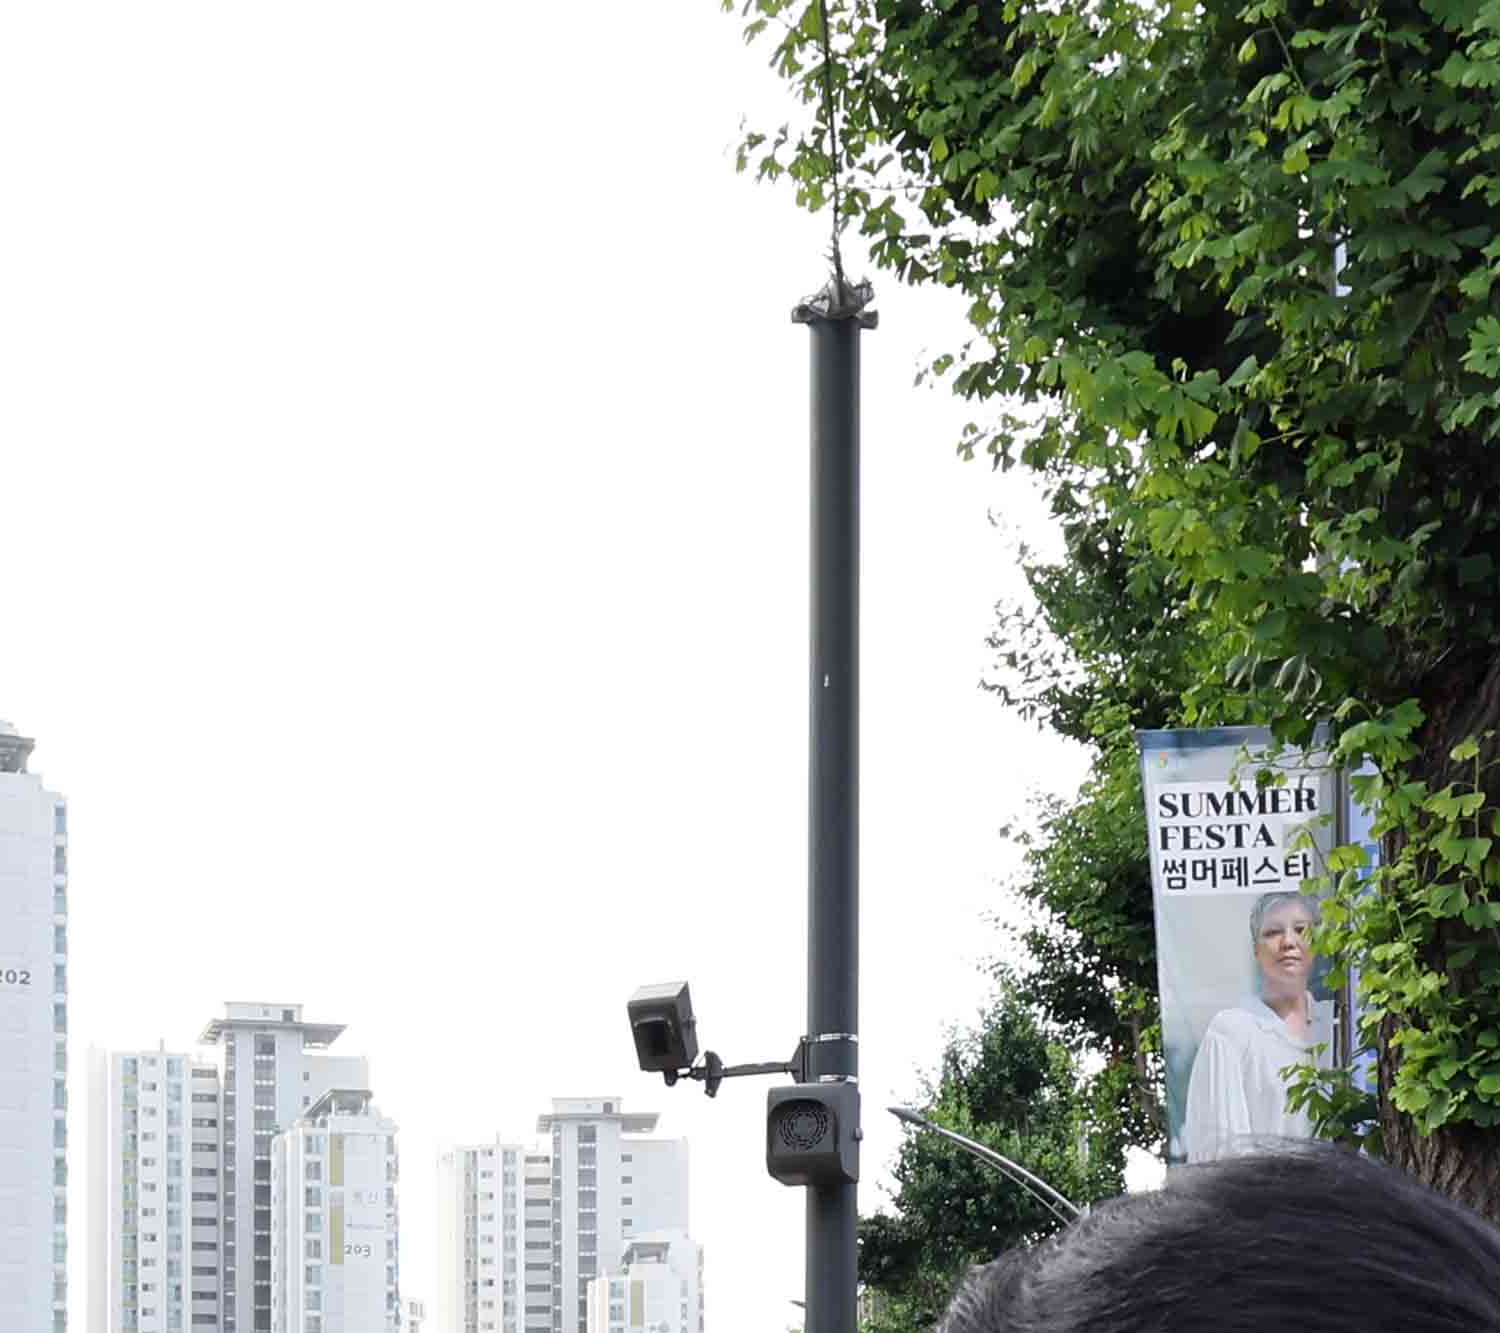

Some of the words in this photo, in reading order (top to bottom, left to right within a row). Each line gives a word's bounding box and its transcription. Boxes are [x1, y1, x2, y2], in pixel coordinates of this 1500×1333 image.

[1158, 784, 1320, 819] SUMMER
[1159, 823, 1276, 851] FESTA
[1161, 856, 1312, 891] 썸머페스타
